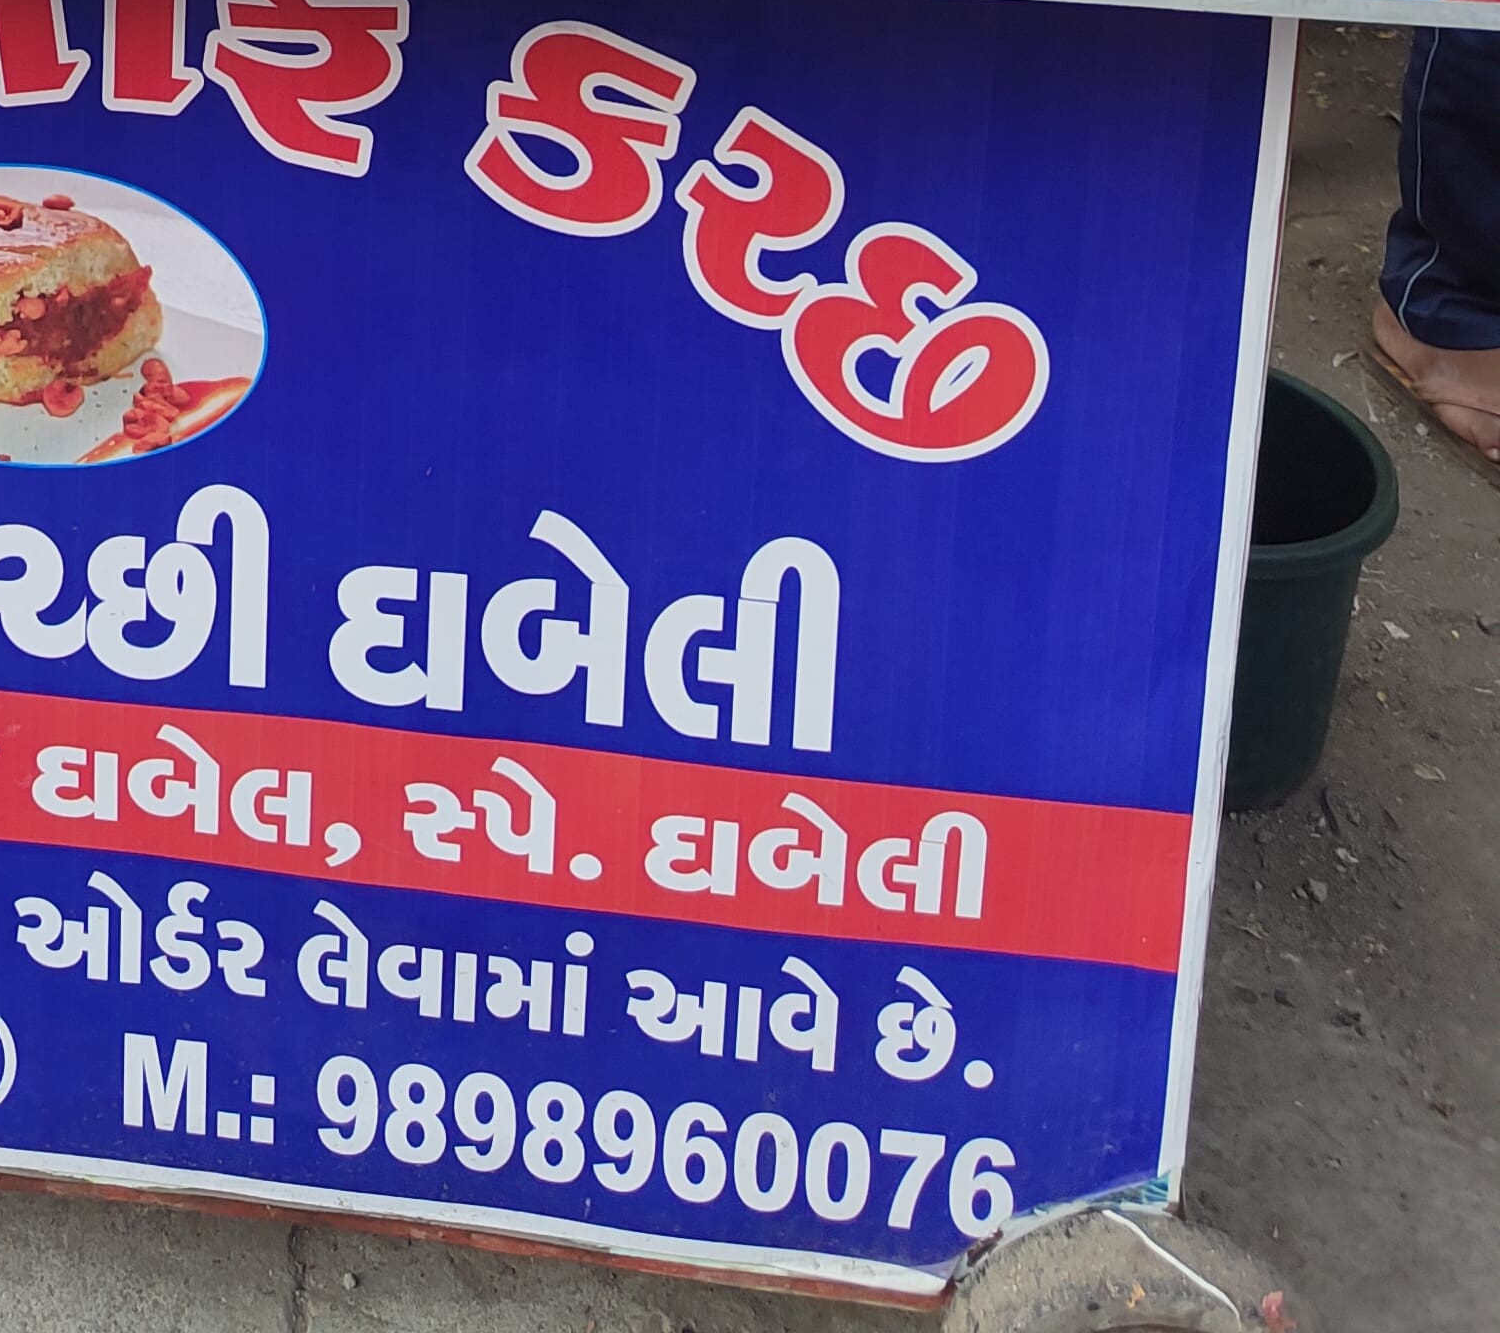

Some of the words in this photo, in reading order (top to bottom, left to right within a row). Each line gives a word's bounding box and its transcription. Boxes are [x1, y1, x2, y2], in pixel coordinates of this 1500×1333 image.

[463, 20, 1051, 463] કચ્છ
[328, 510, 840, 753] દાબેલી
[31, 724, 362, 868] દાબેલ,
[403, 756, 603, 881] સ્પે.
[644, 792, 988, 919] દાબેલી
[14, 870, 266, 998] ઓર્ડર
[297, 899, 595, 1037] લેવામાં
[626, 956, 839, 1072] આવે
[875, 966, 994, 1089] છે.
[316, 1055, 1018, 1239] 9898960076
